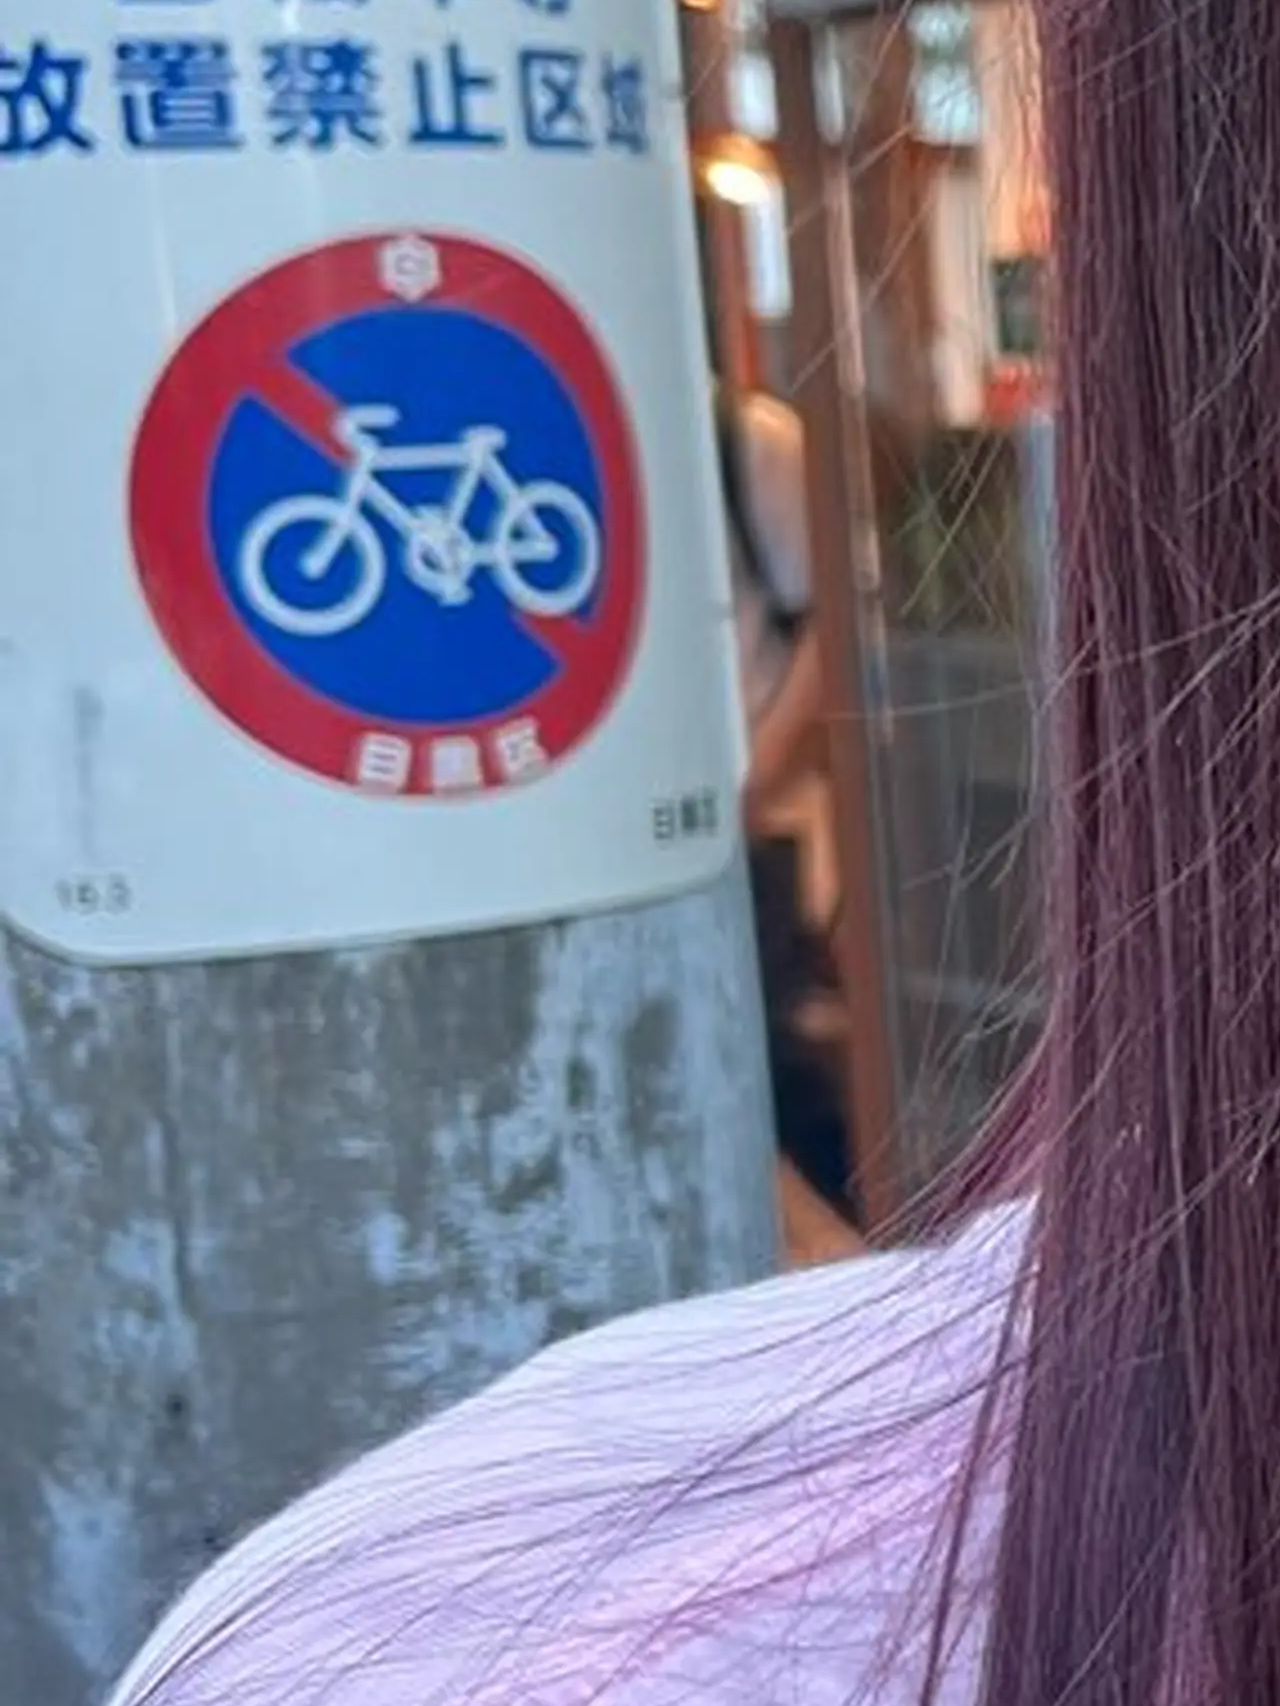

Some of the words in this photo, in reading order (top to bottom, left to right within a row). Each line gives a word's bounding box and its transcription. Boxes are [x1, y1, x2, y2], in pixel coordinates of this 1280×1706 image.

[0, 39, 650, 155] 放置禁止区域
